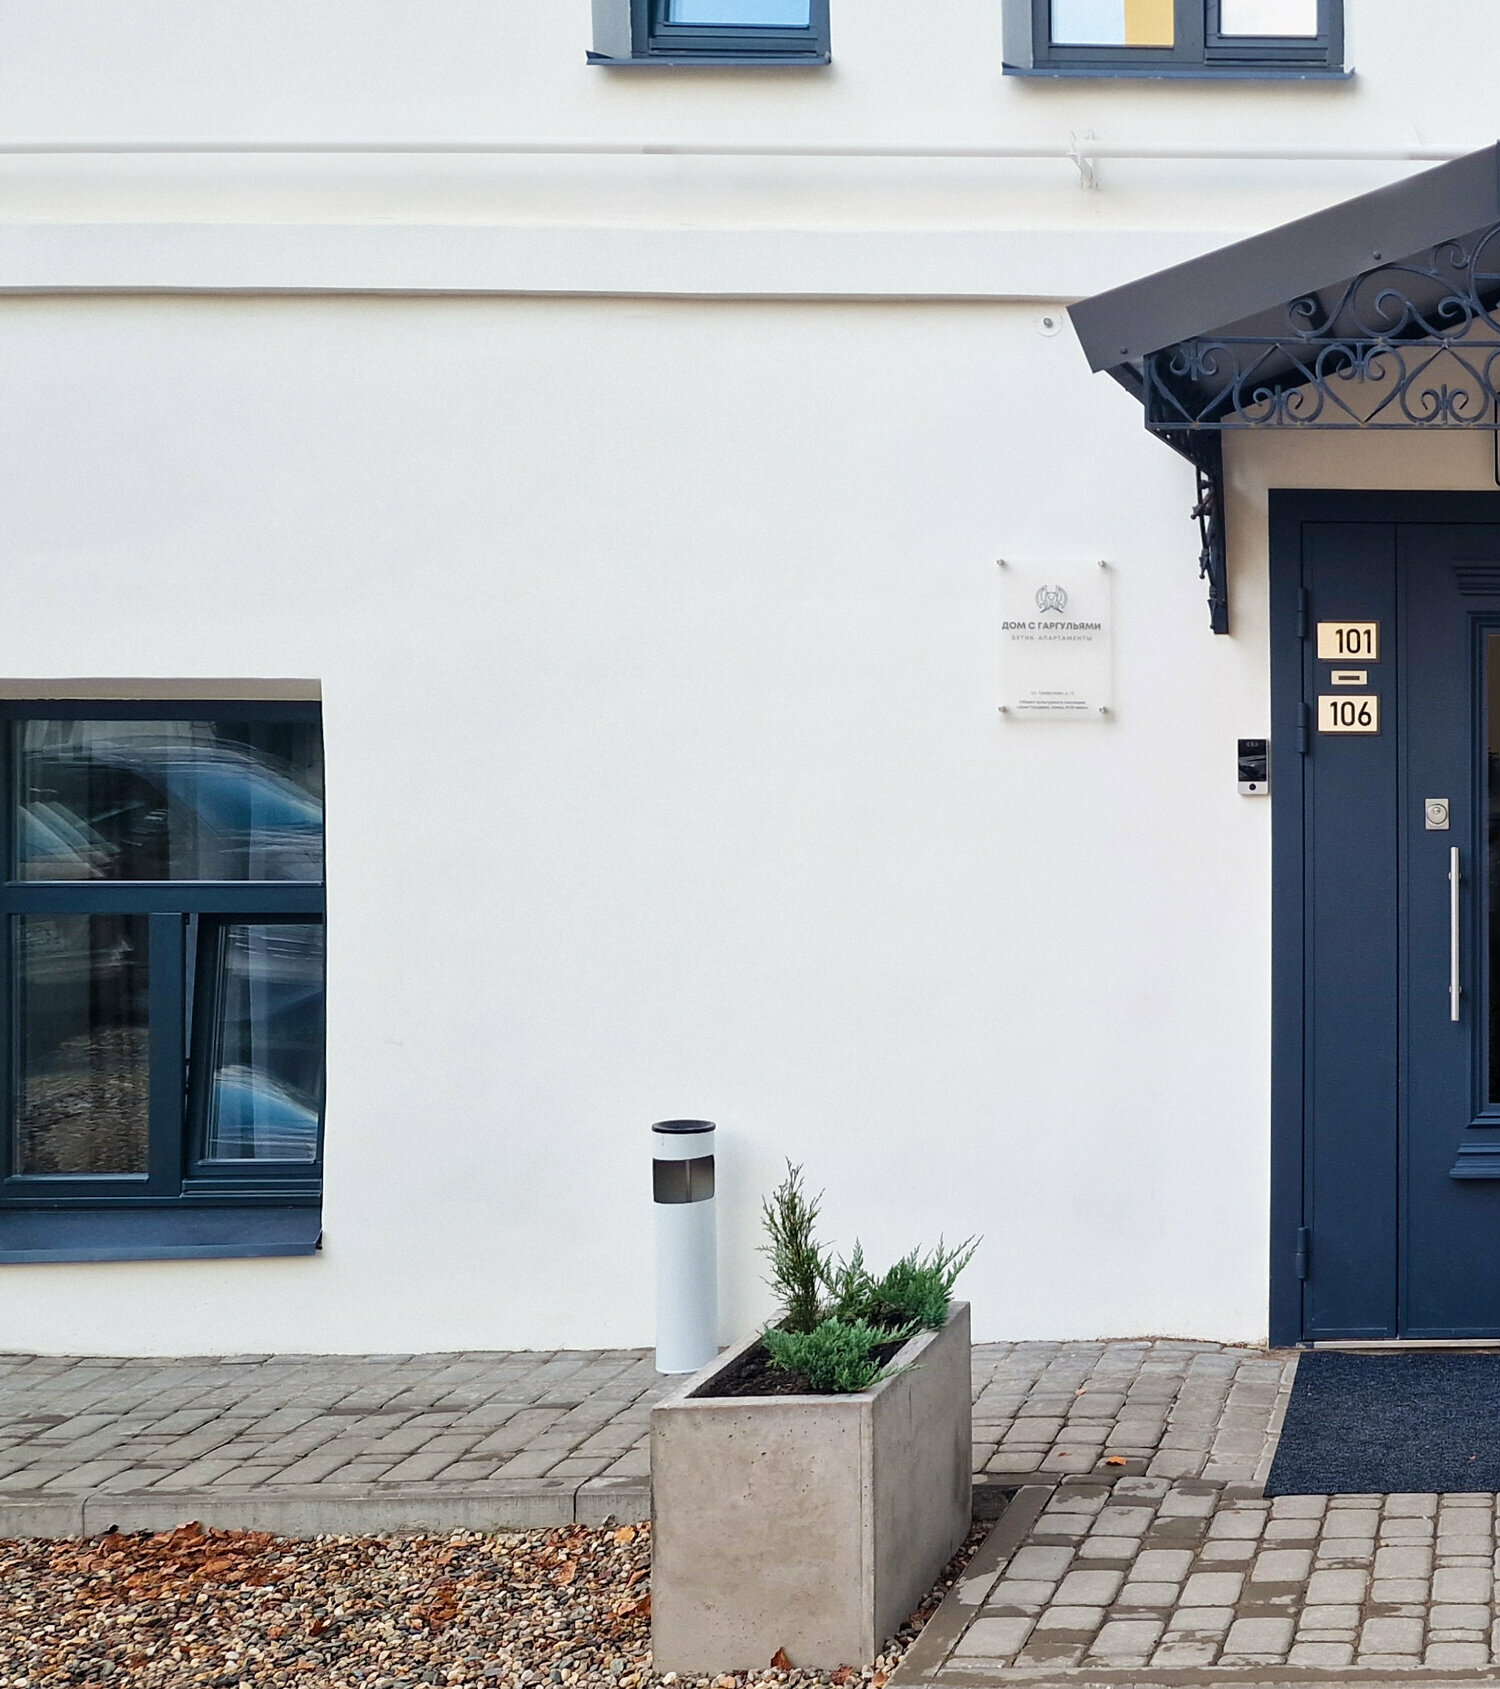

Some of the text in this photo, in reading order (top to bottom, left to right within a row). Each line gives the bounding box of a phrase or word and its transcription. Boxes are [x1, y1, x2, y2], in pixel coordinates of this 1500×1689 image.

[1001, 621, 1101, 631] ДОМ С ГАРГУЛЬЯМИ
[1335, 628, 1371, 654] 101
[1330, 701, 1372, 727] 106
